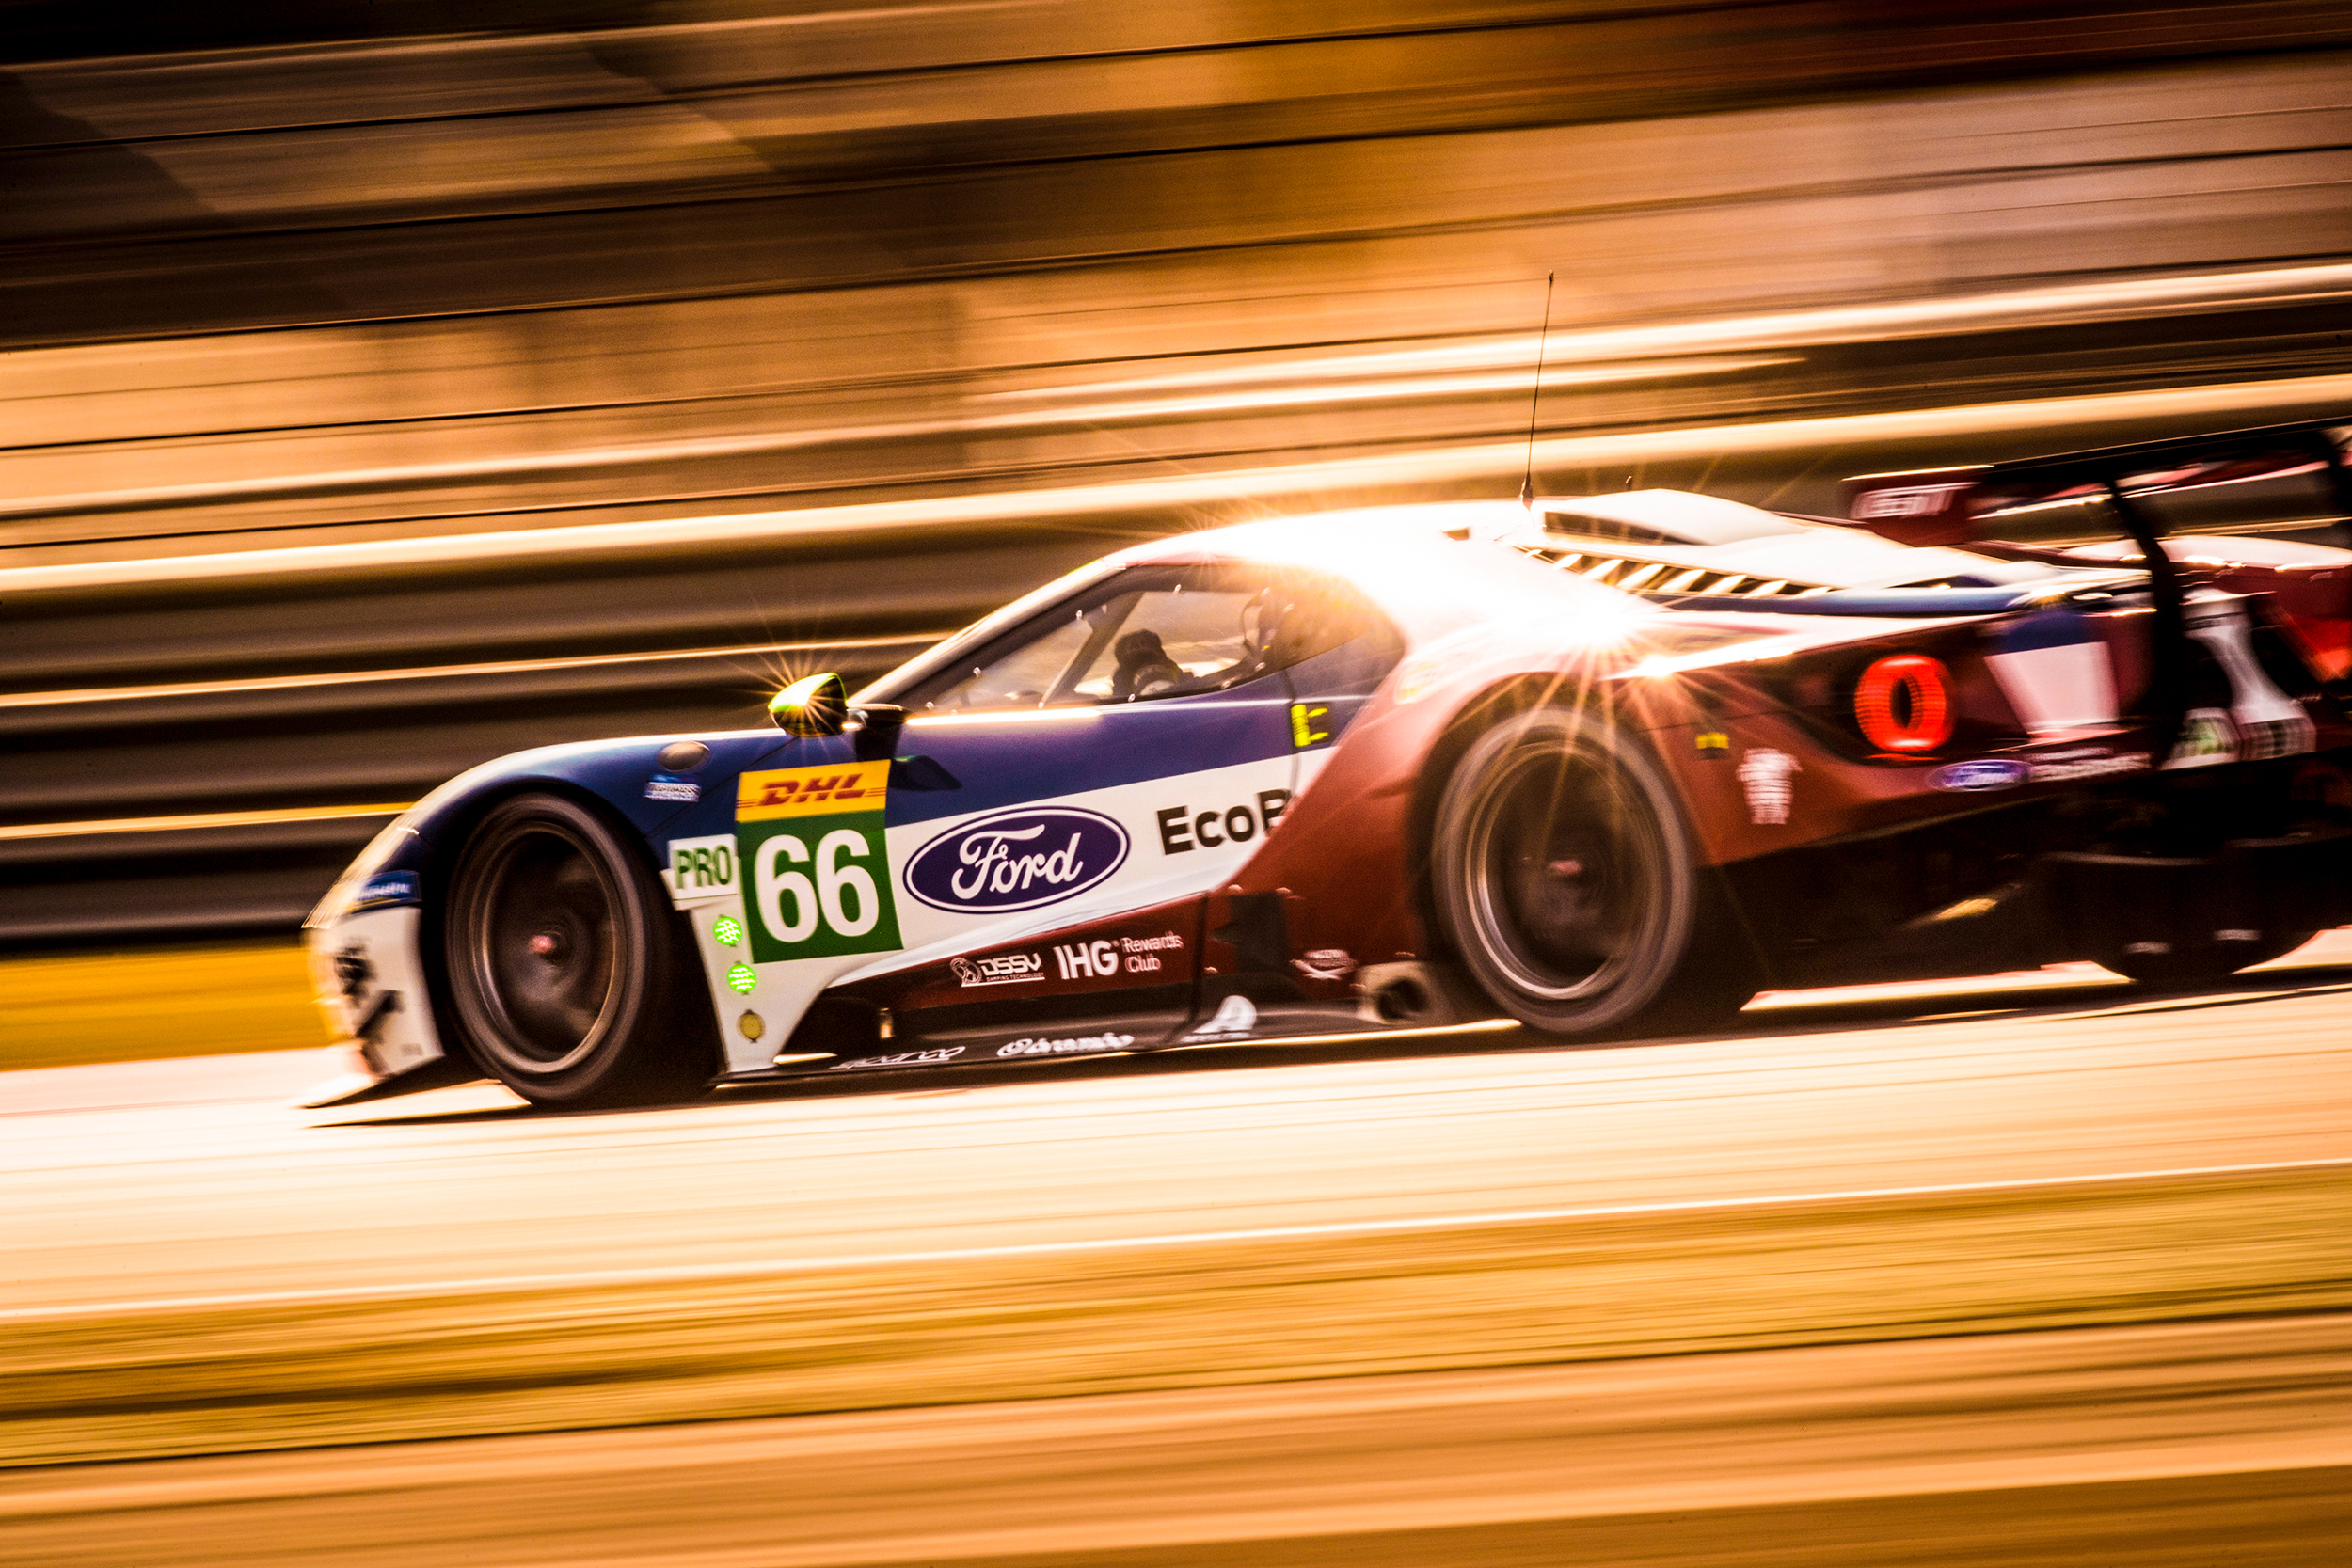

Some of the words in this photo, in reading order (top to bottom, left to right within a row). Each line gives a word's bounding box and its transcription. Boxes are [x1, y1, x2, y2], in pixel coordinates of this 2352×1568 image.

[757, 773, 866, 806] DHL
[673, 845, 733, 890] PRO
[951, 824, 1084, 899] Ford
[755, 829, 880, 942] 66
[1120, 930, 1184, 953] Rewards
[977, 952, 1042, 976] DSSV
[1053, 940, 1119, 980] IHG
[1124, 953, 1162, 973] Club
